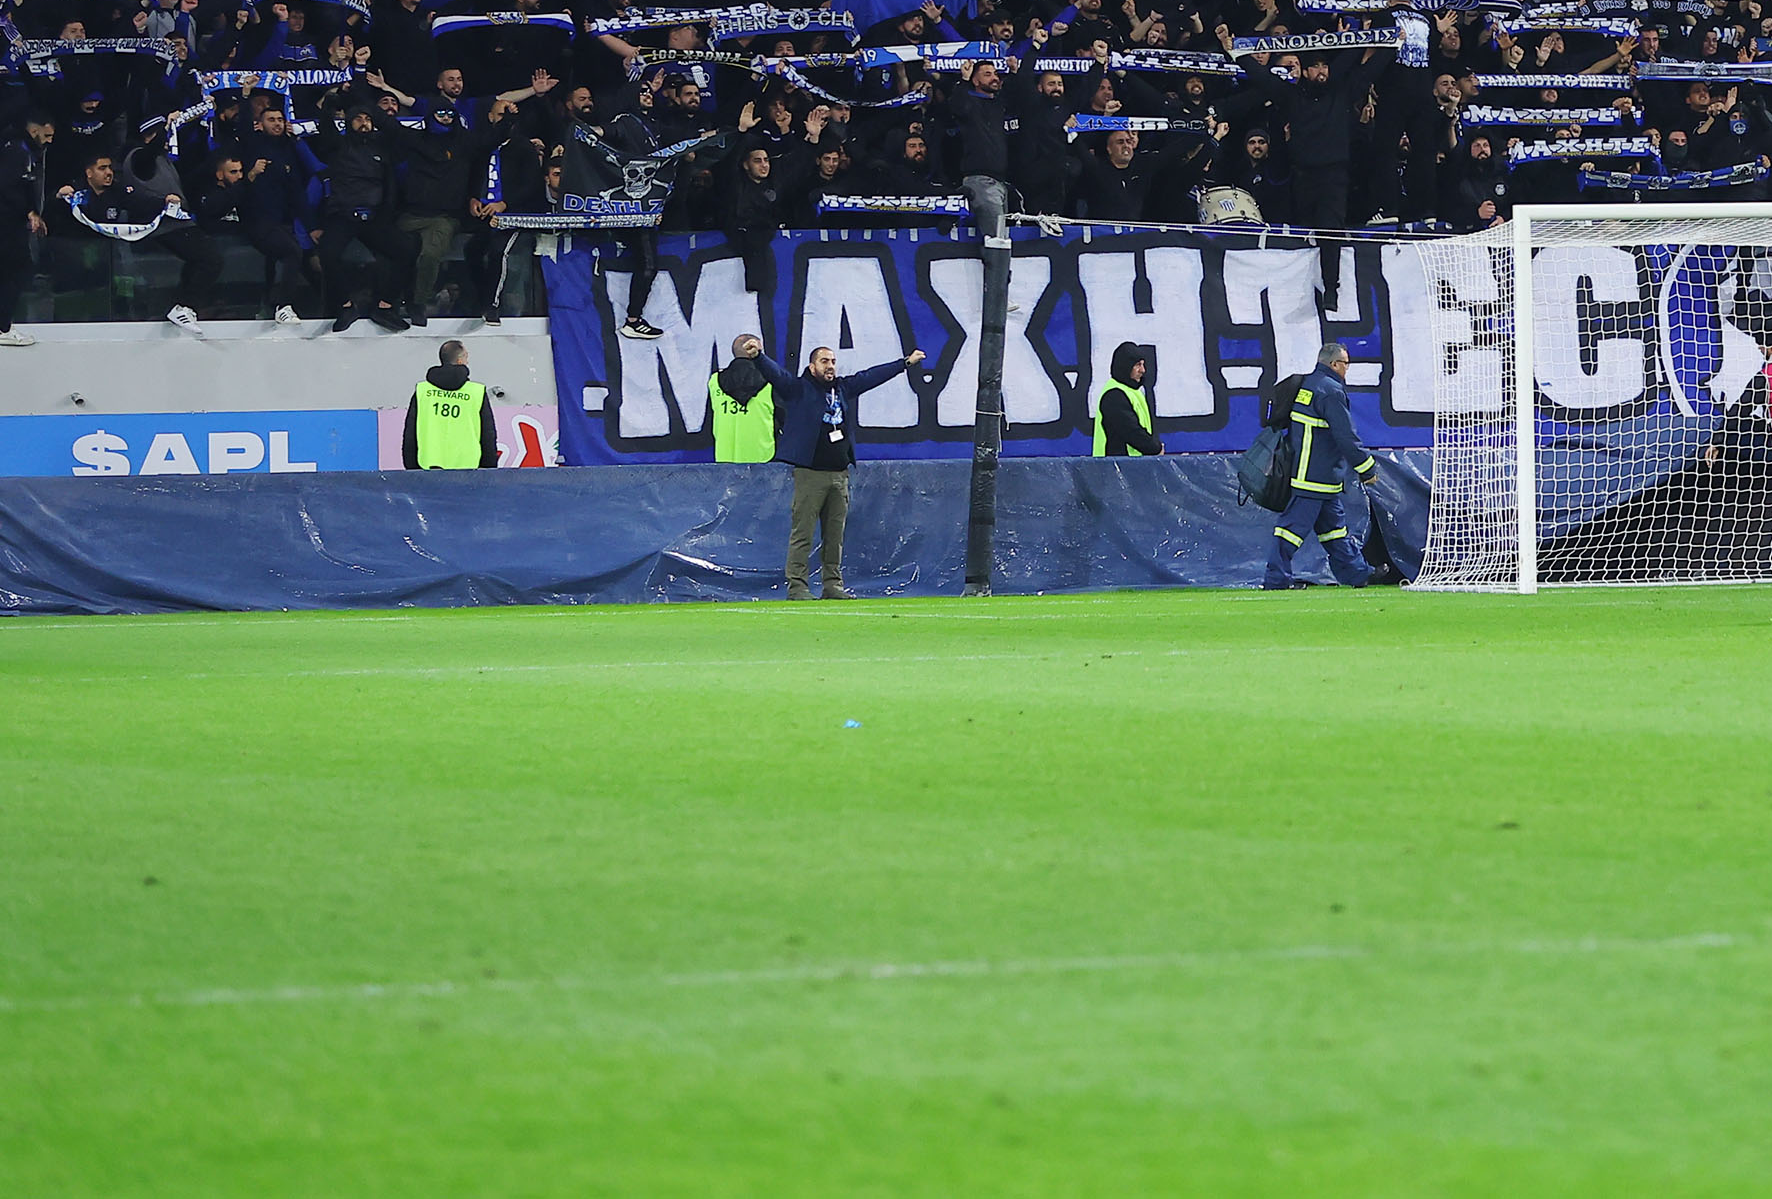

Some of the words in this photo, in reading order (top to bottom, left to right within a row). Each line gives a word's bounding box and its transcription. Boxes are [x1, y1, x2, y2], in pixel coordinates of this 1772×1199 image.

[714, 13, 779, 37] THENS
[1254, 27, 1398, 51] ΑΝΟΡΘΩΣΙΣ
[1477, 73, 1563, 88] FAMAGUSTA
[562, 193, 642, 214] DEATH
[426, 390, 471, 402] STEWARD
[432, 402, 461, 418] 180
[721, 400, 749, 415] 134
